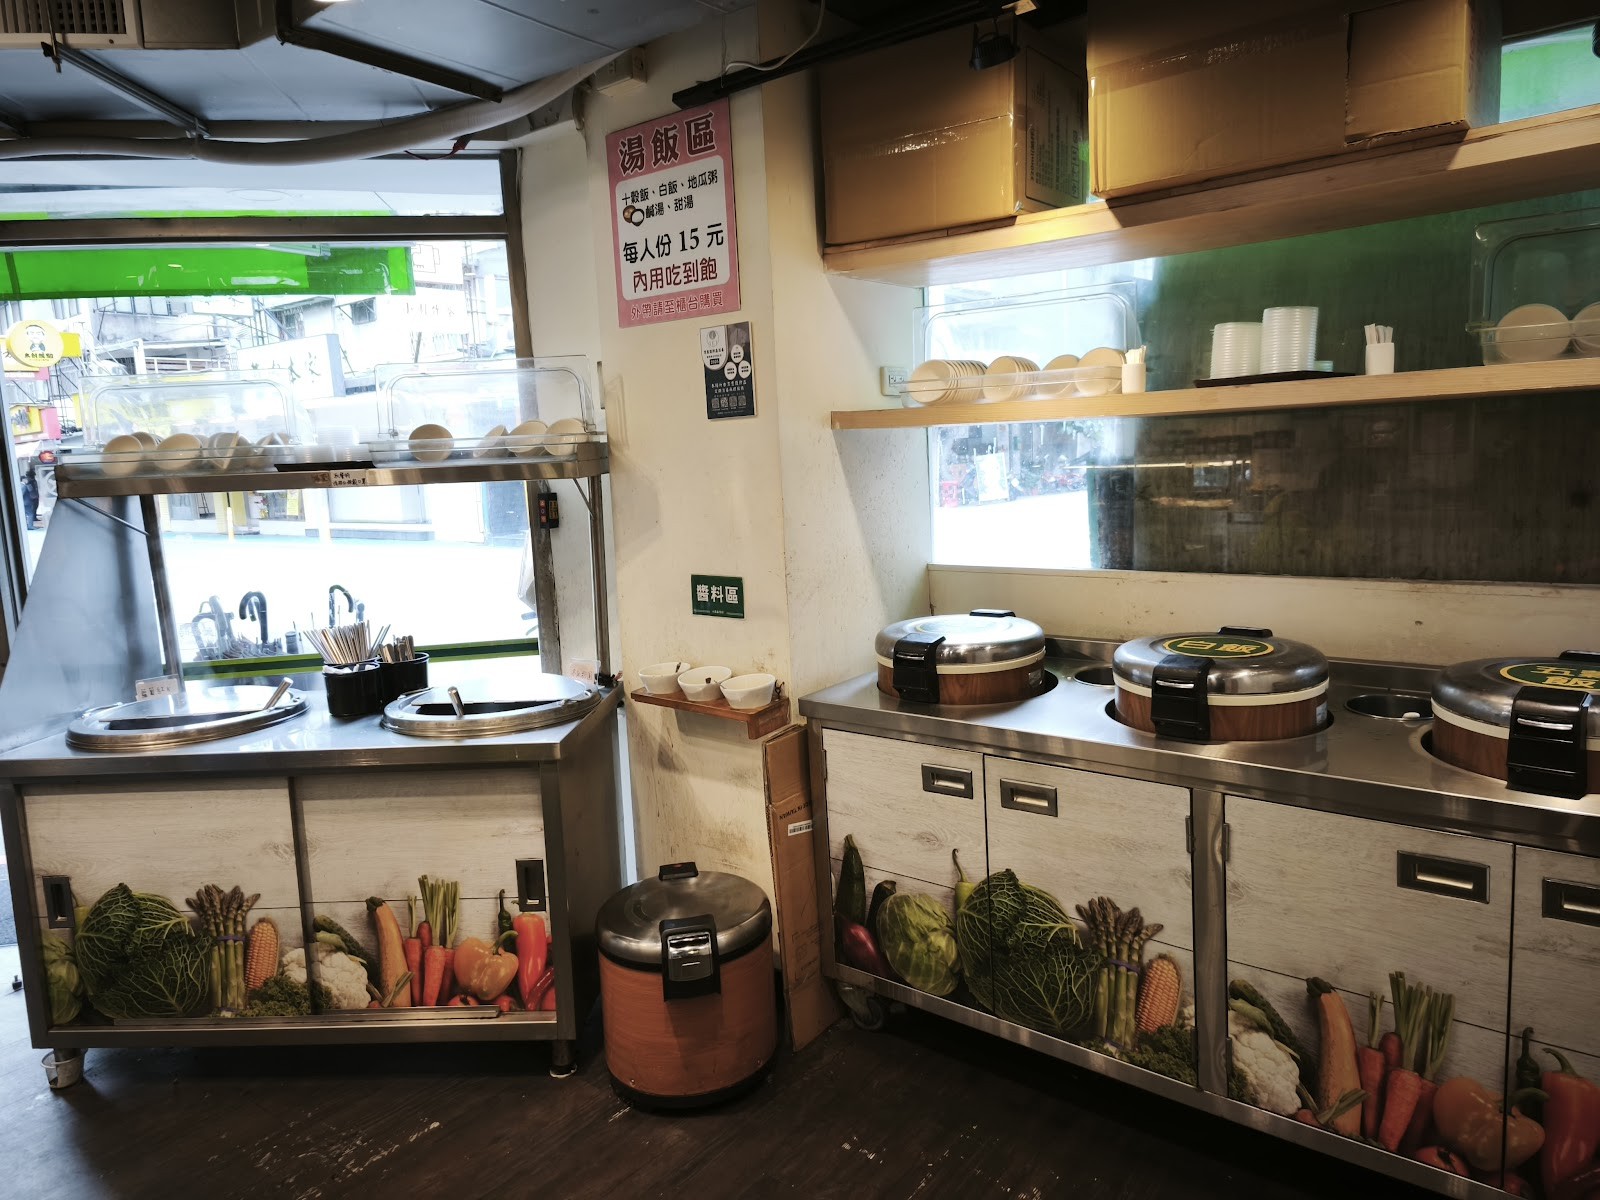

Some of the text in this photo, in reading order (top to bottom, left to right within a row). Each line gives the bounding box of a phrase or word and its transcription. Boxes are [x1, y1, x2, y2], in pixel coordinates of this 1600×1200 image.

[618, 111, 717, 175] 湯飯區
[621, 169, 718, 206] 十穀飯、白飯、地瓜粥
[623, 222, 724, 264] 每人份 15 元
[633, 256, 718, 294] 內用吃到飽
[631, 291, 723, 320] 外帶請至櫃台購買
[696, 584, 739, 604] 醬料區
[1177, 640, 1261, 654] 白飯
